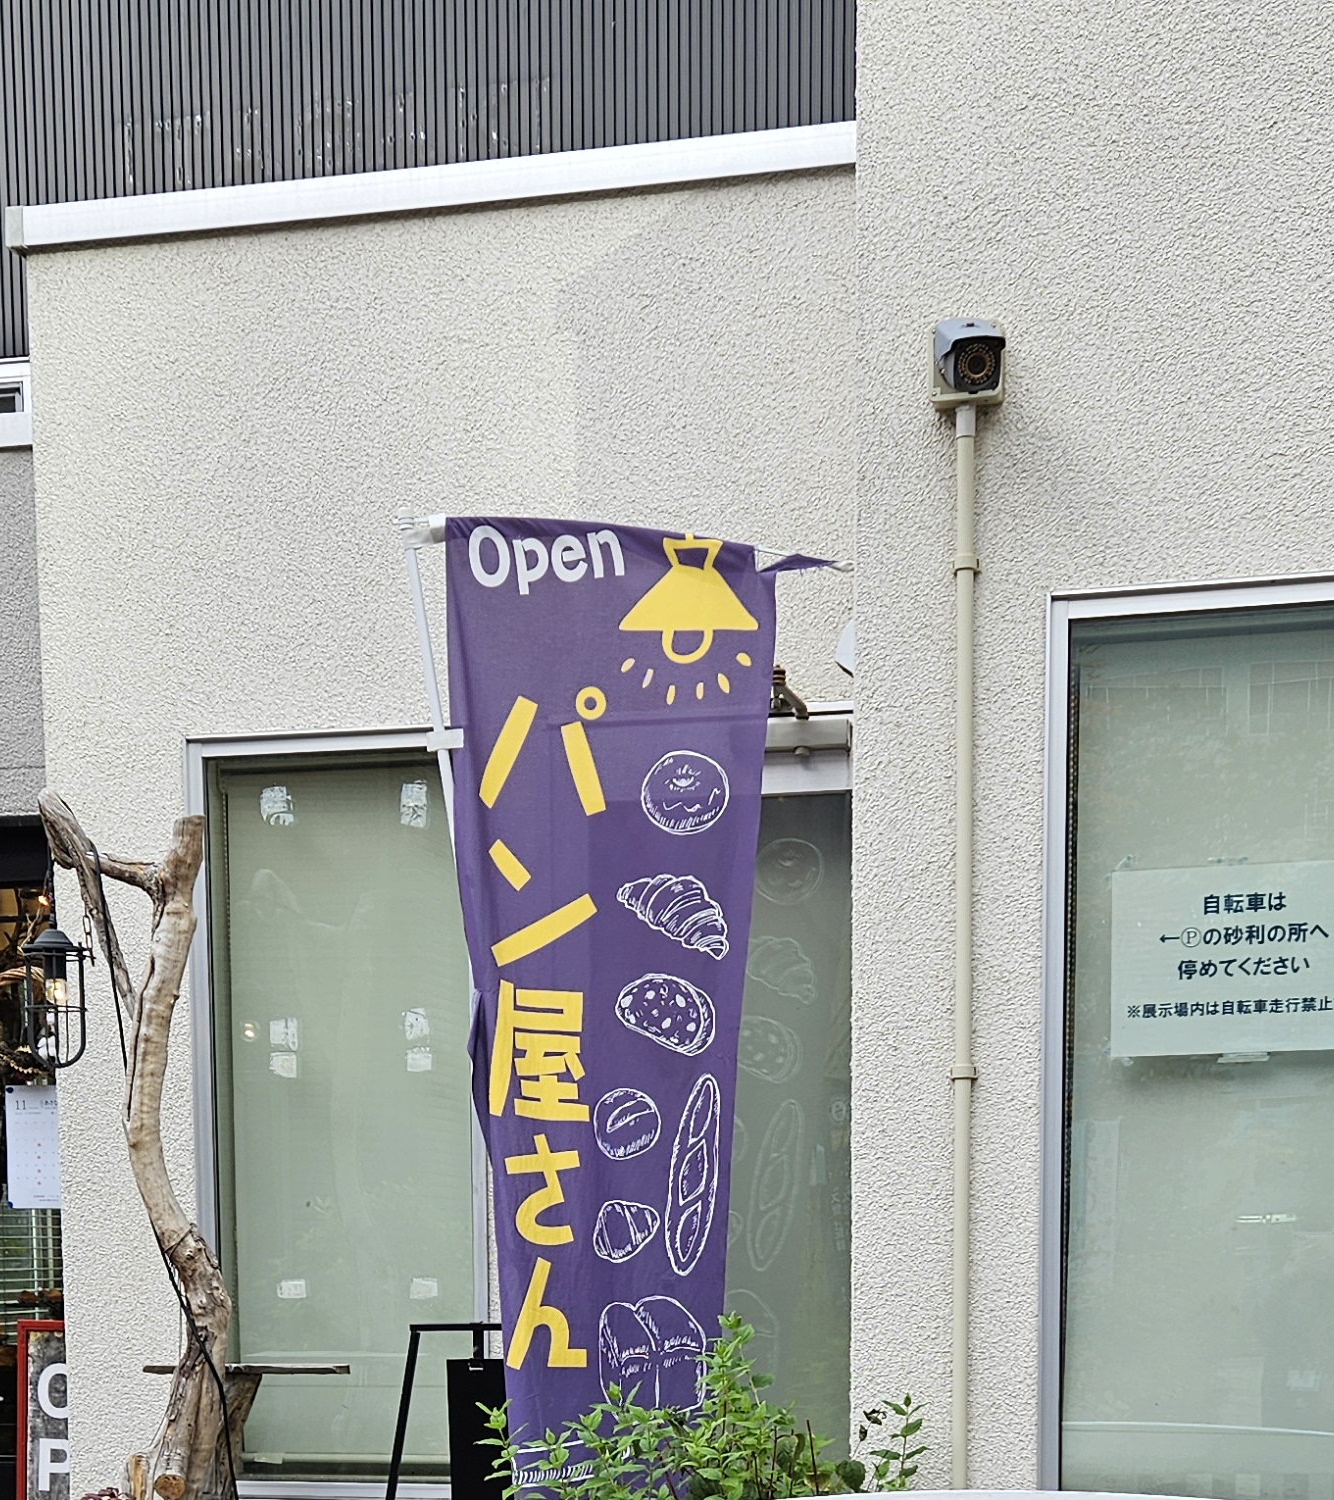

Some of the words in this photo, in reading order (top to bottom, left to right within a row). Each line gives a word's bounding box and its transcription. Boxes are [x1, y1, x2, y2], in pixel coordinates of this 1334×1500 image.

[468, 525, 625, 596] Open
[1202, 891, 1287, 915] 自転車は
[1177, 956, 1310, 980] 停めてください
[477, 686, 607, 1371] パン屋さん
